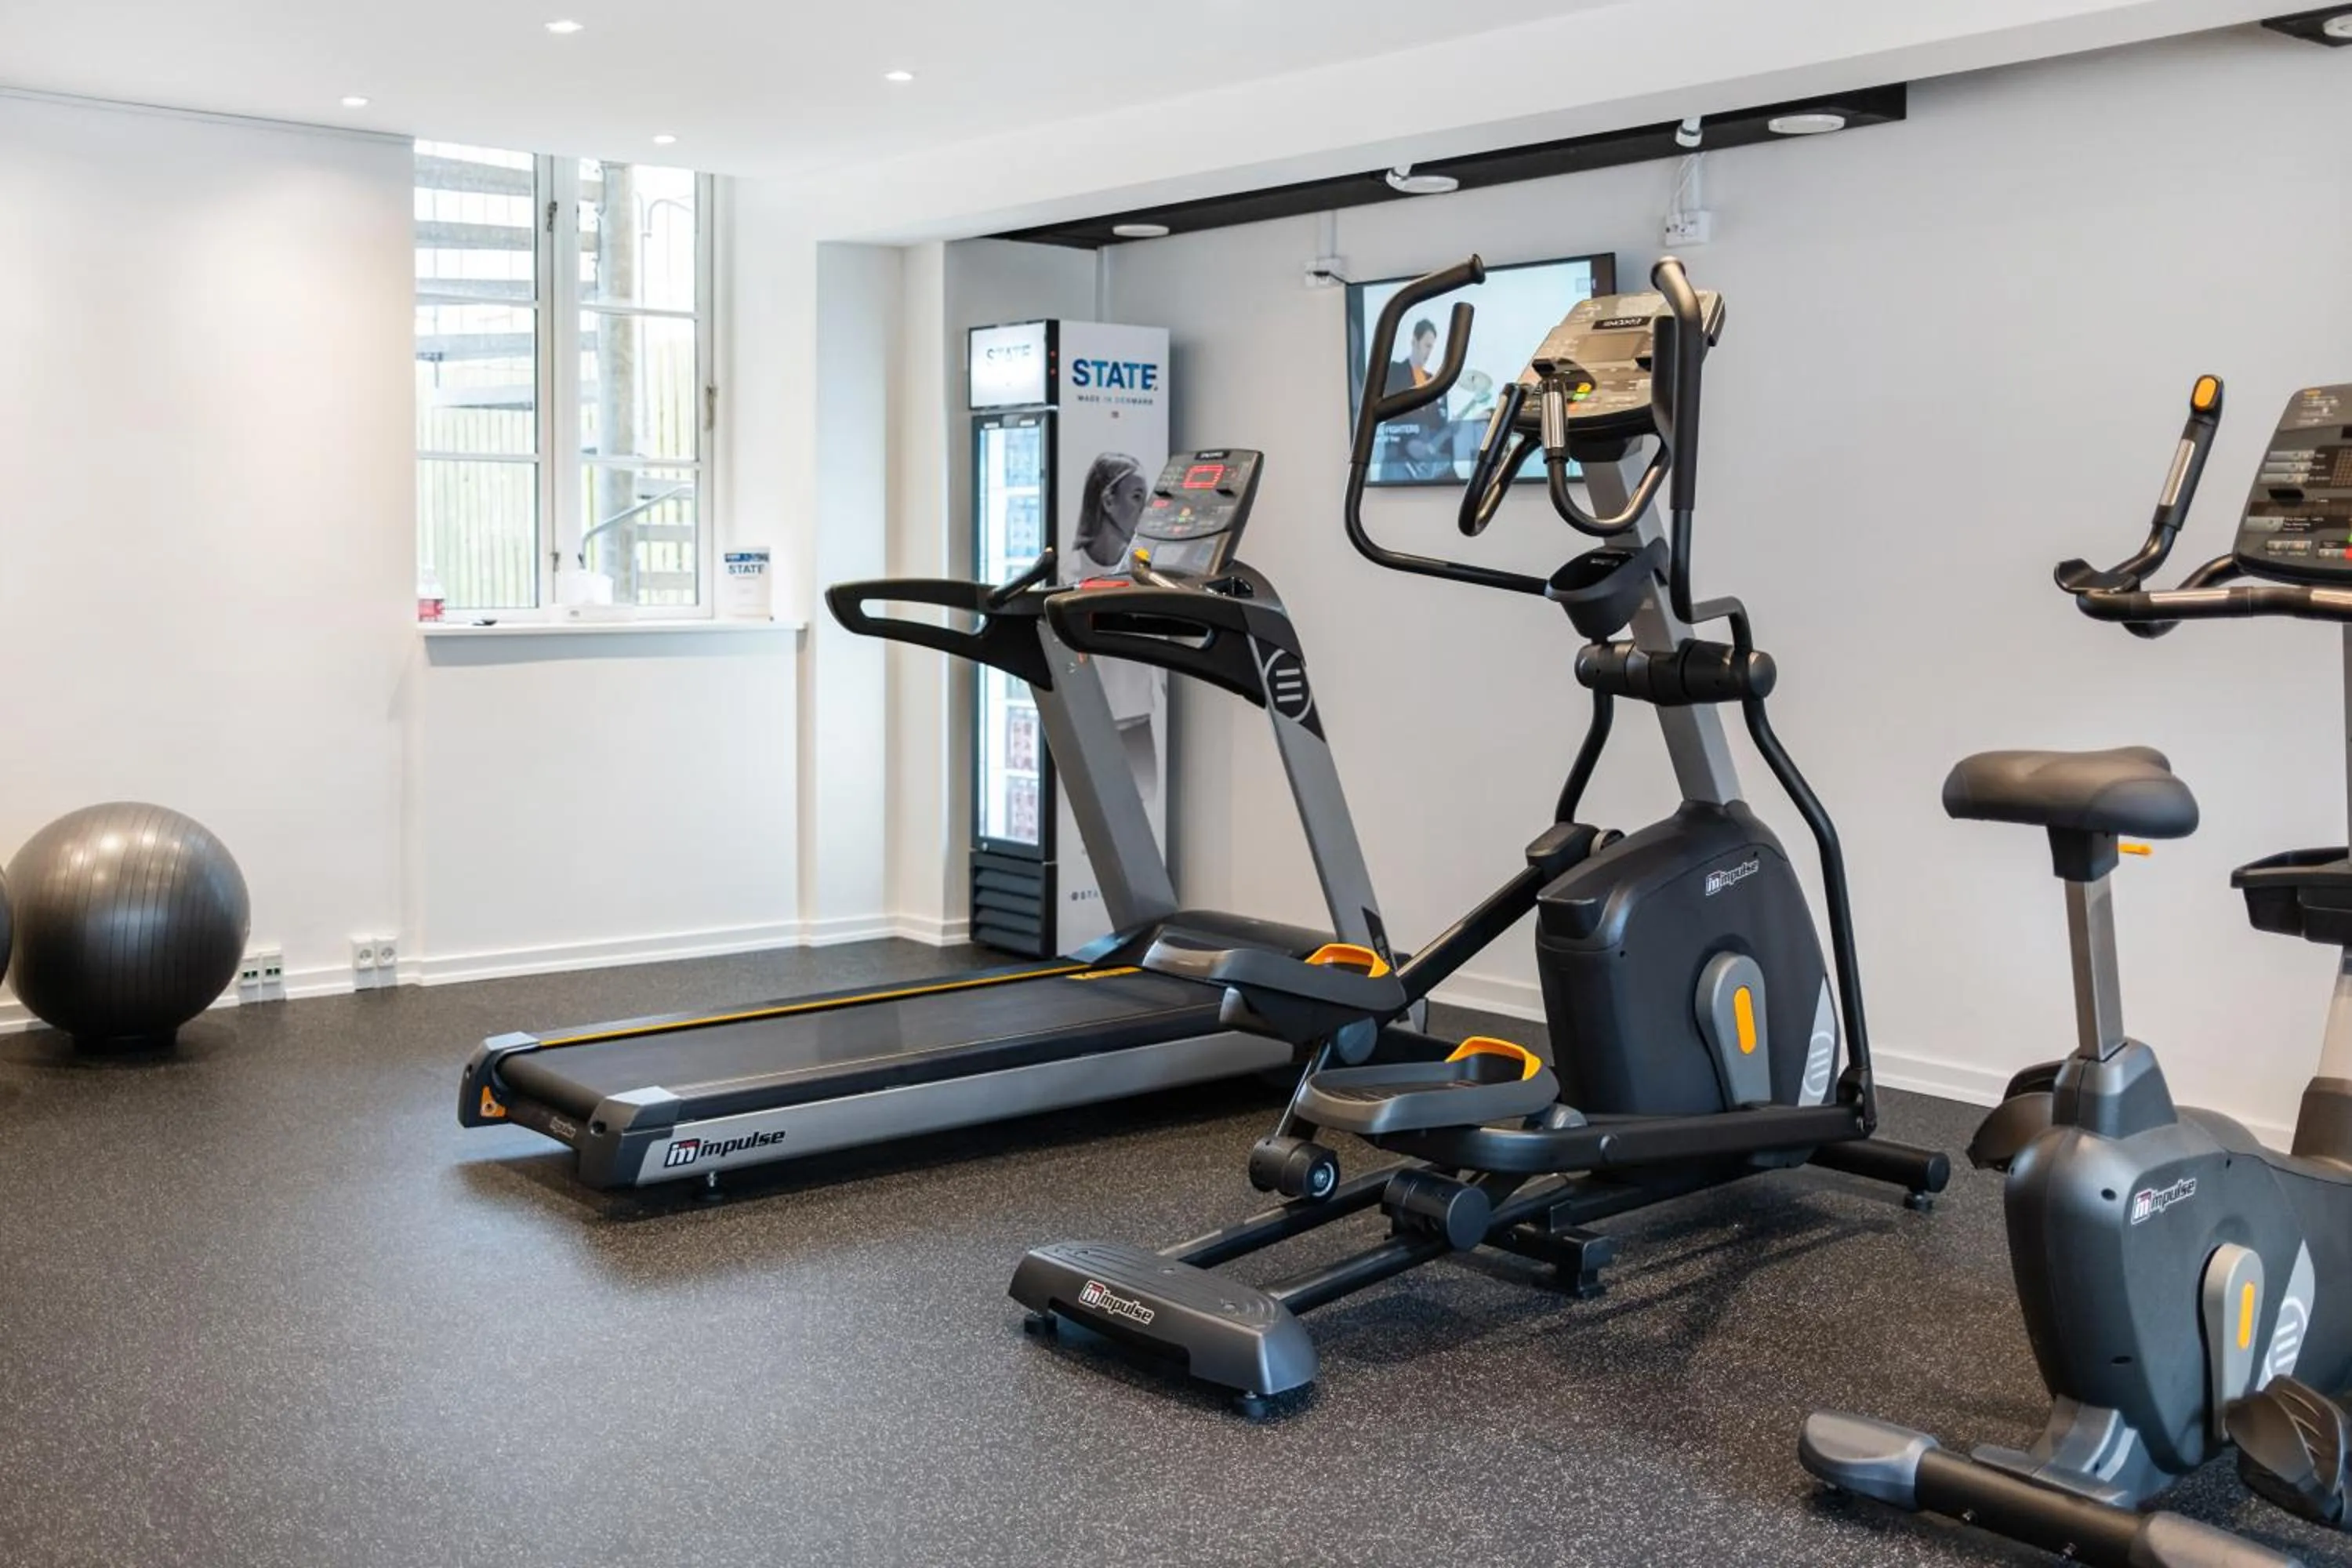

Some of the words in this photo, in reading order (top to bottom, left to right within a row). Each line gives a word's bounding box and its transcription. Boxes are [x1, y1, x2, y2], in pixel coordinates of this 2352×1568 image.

[728, 563, 765, 575] STATE
[700, 1131, 786, 1157] impulse
[1098, 1290, 1154, 1324] impulse
